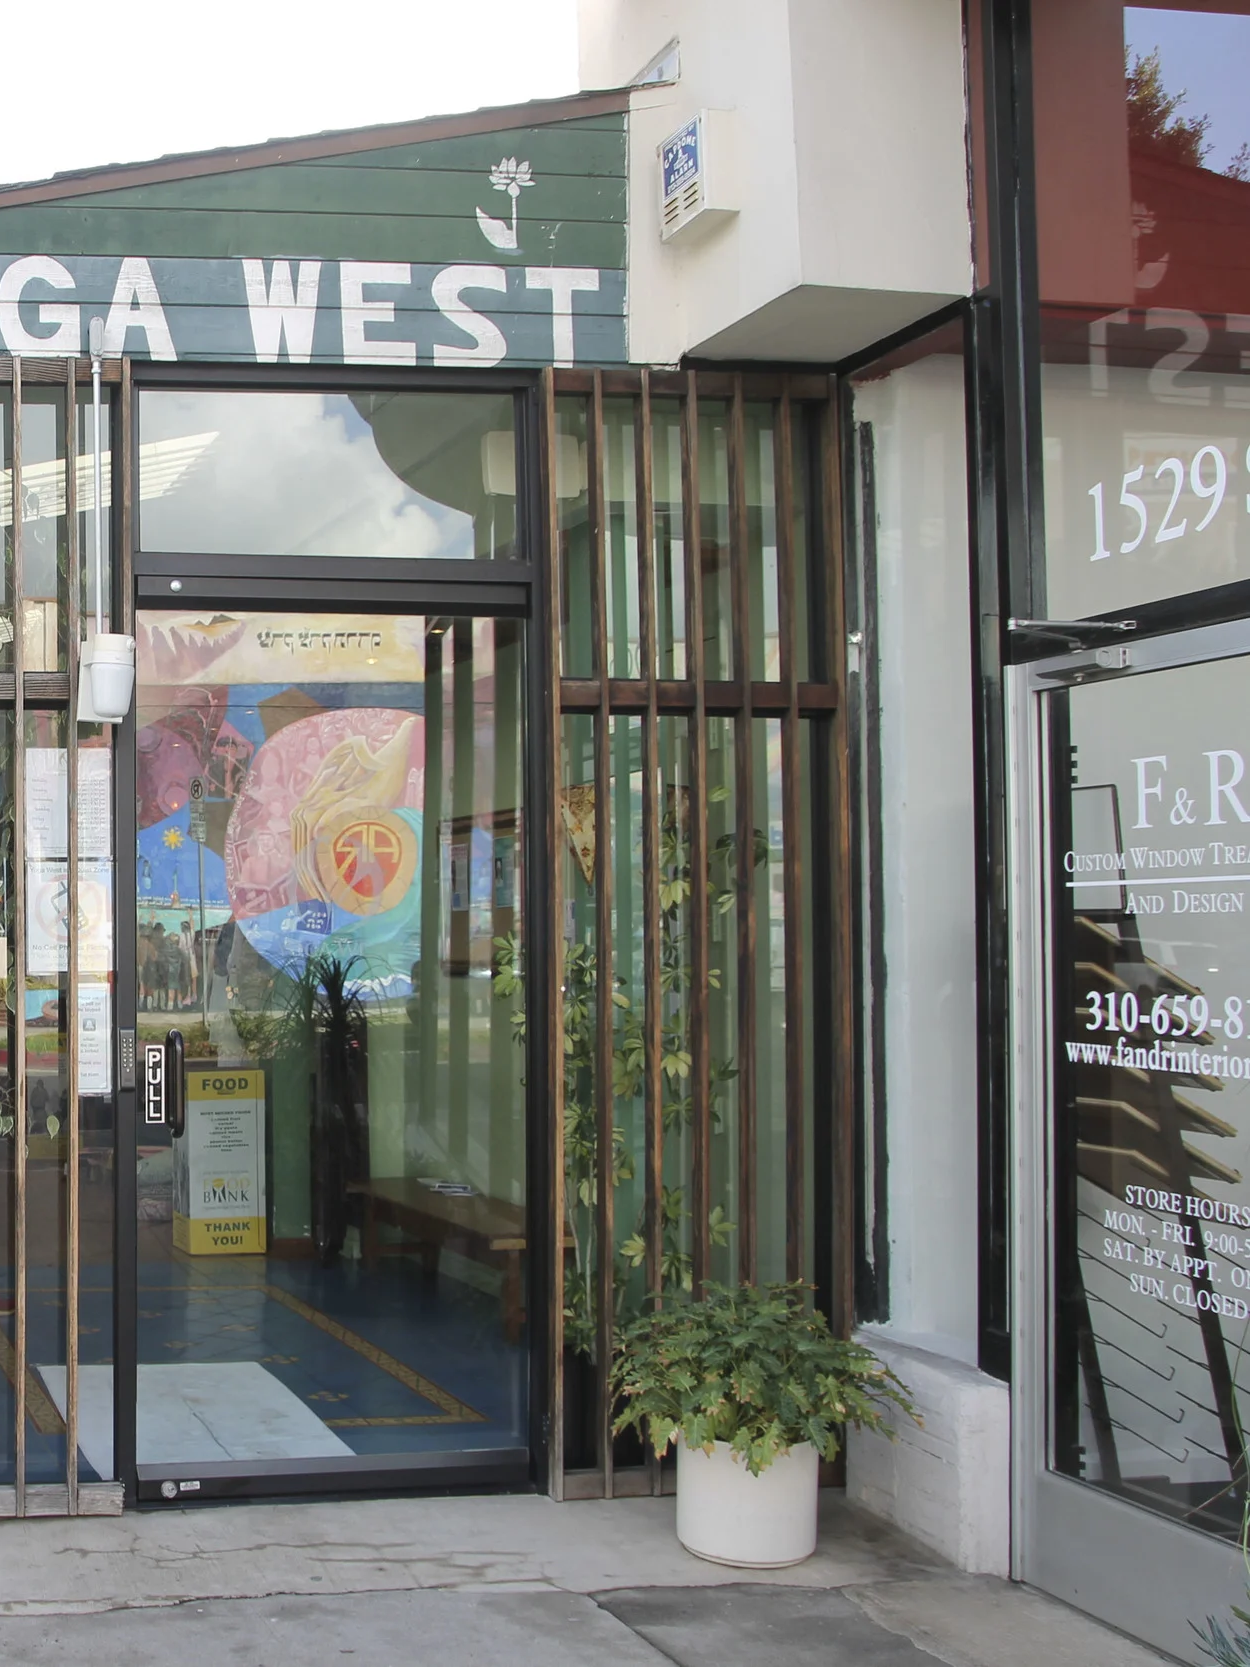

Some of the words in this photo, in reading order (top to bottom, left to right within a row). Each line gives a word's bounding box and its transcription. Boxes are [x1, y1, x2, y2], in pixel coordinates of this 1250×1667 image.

[243, 258, 600, 369] WEST
[1088, 445, 1227, 562] 1529
[149, 1051, 161, 1117] PULL
[202, 1078, 248, 1091] FOOD
[205, 1223, 250, 1232] THANK
[1125, 1185, 1181, 1214] STORE
[1186, 1195, 1250, 1227] HOURS
[212, 1236, 243, 1246] YOU!
[1104, 1210, 1145, 1235] MON.
[1161, 1220, 1195, 1247] FRI.
[1104, 1238, 1138, 1263] SAT.
[1144, 1246, 1166, 1269] BY
[1170, 1254, 1221, 1282] APPT.
[1130, 1273, 1168, 1300] SUN.
[1173, 1284, 1248, 1319] CLOSED
